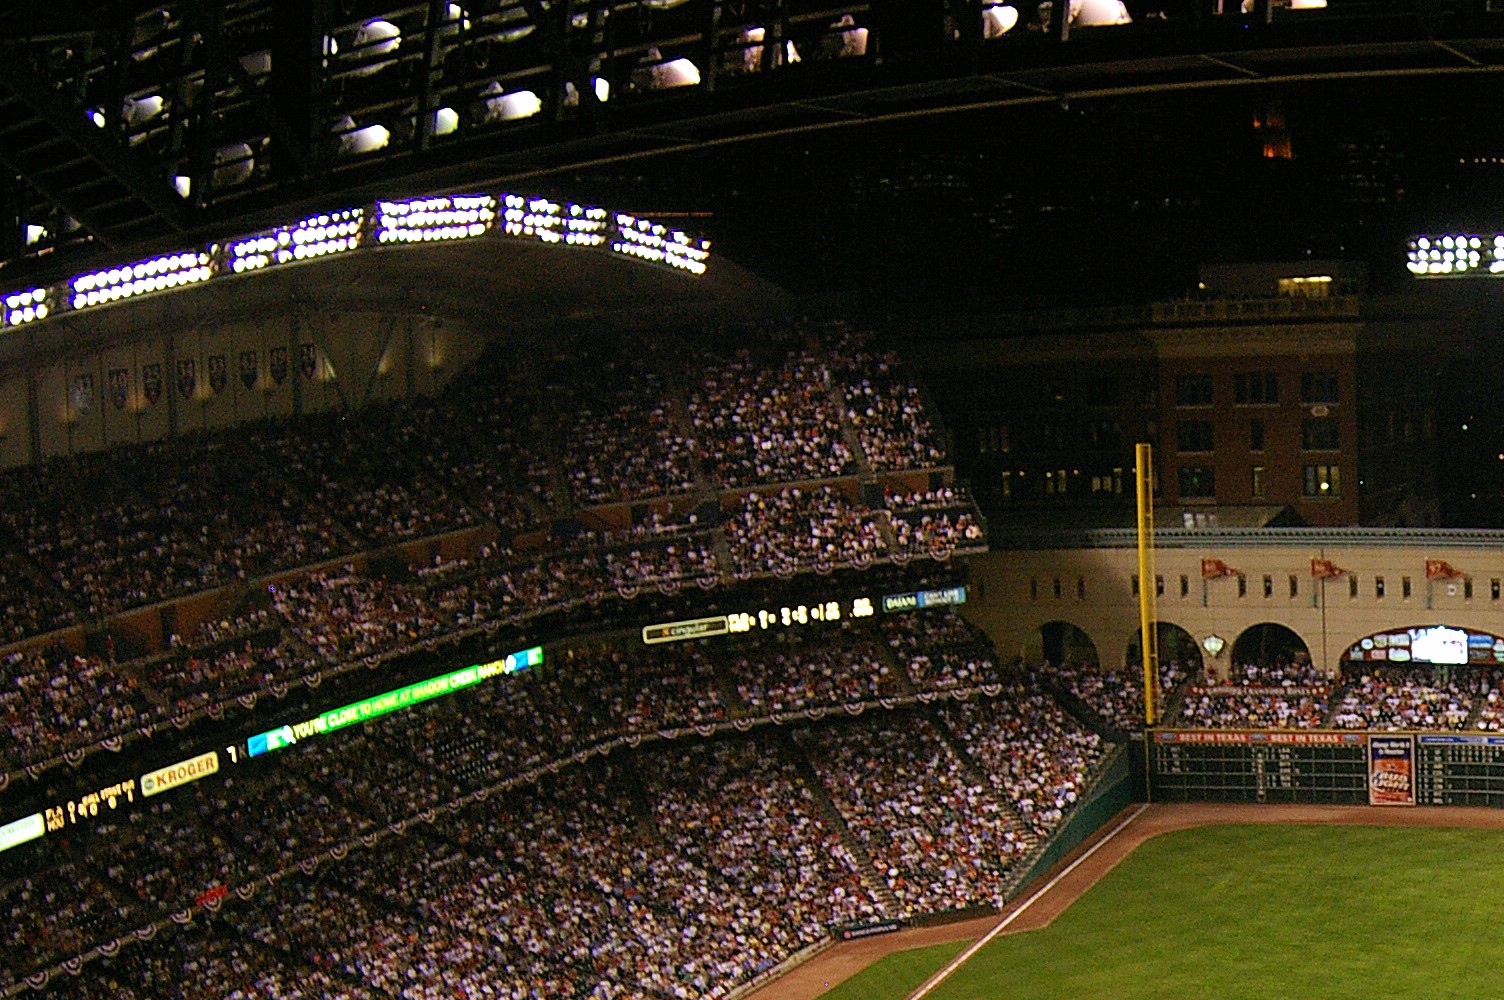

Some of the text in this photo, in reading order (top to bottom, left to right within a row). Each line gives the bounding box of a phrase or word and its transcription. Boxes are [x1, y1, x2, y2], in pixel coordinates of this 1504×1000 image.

[360, 702, 372, 716] TO
[1180, 733, 1246, 743] BEST IN TEXAS
[1271, 734, 1338, 743] BEST IN TEXAS
[156, 756, 215, 787] KROGER
